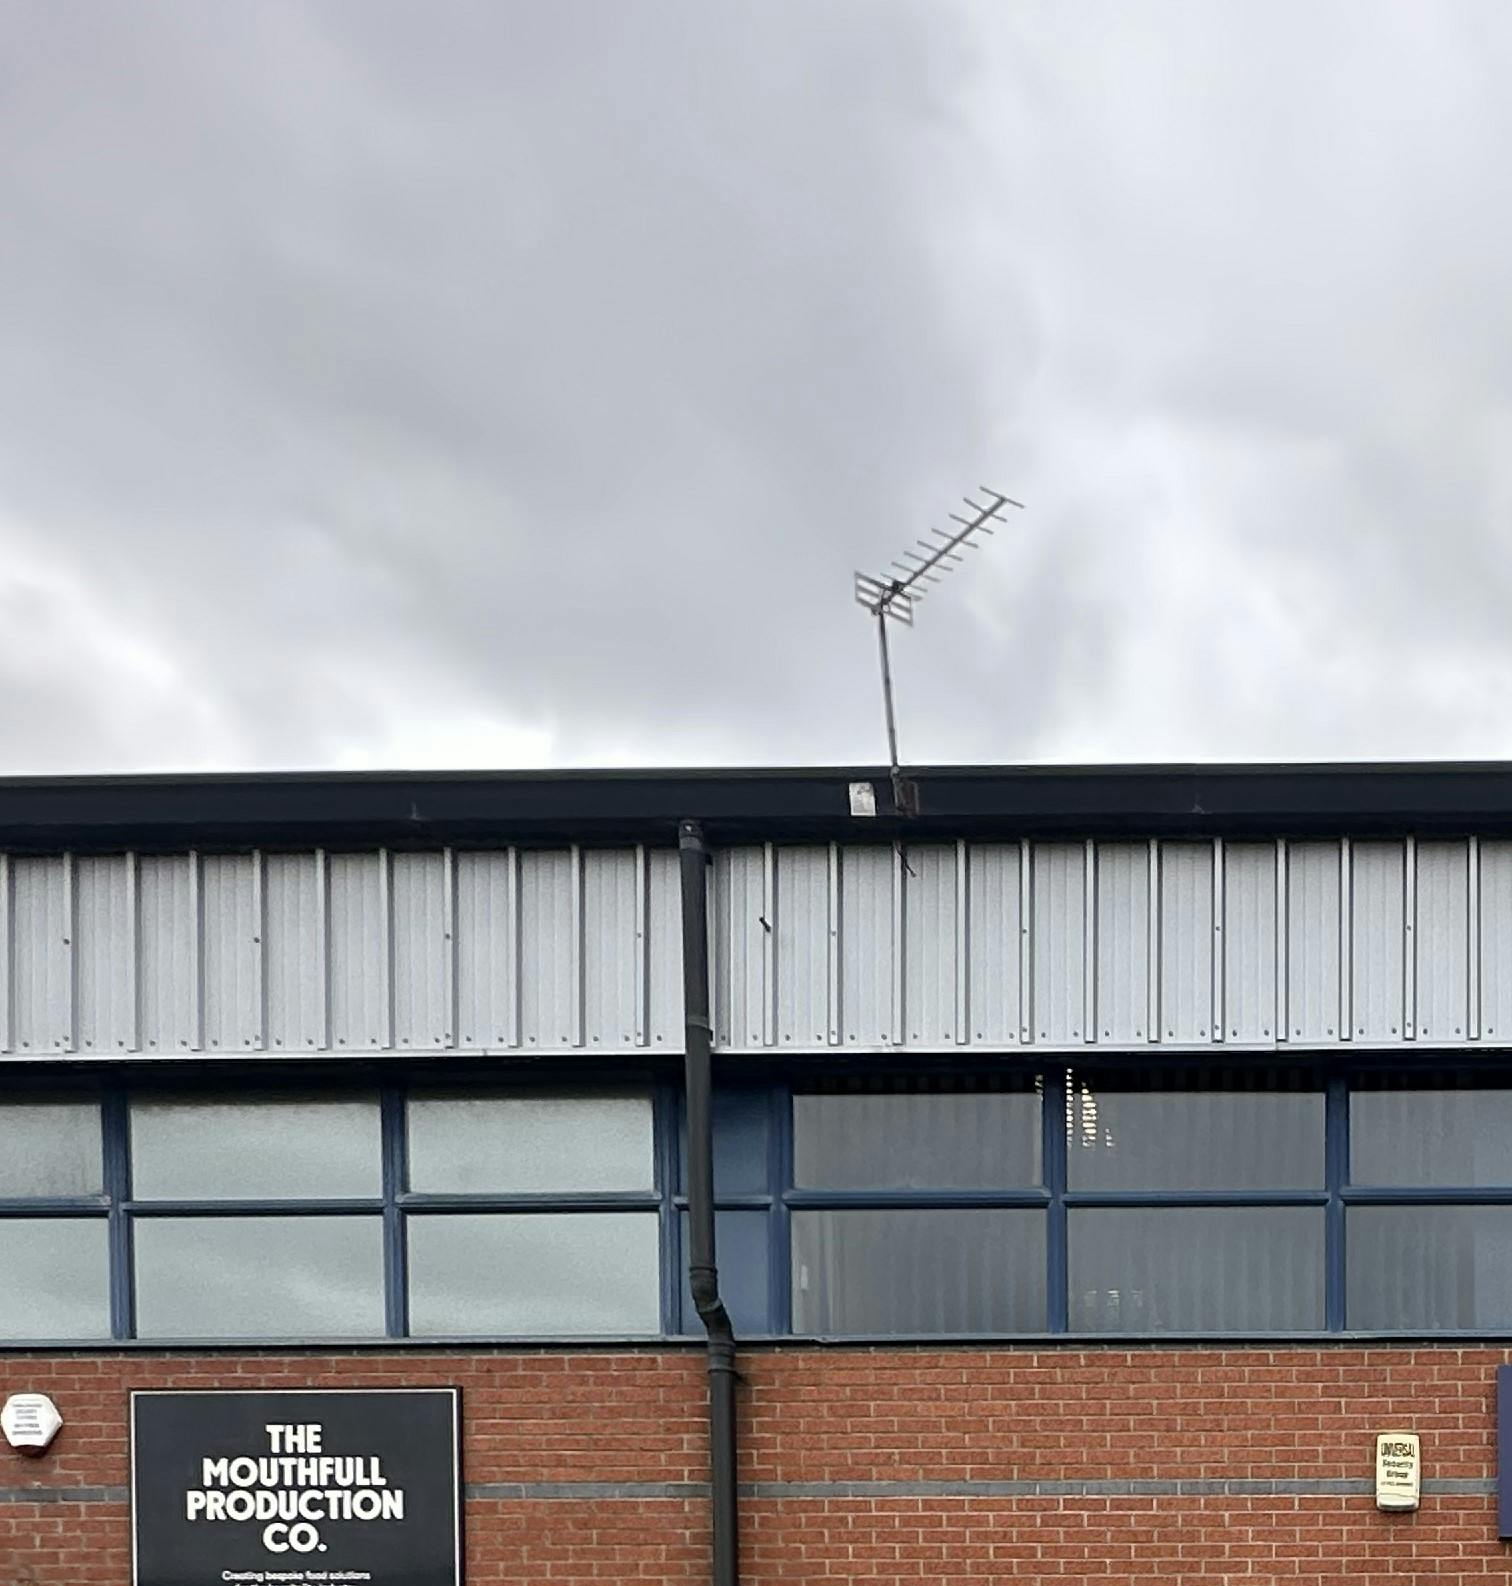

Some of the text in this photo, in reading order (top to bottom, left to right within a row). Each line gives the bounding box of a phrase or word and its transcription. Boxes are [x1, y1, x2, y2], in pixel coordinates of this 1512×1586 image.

[265, 1424, 322, 1453] THE
[202, 1456, 387, 1487] MOUTHFULL
[186, 1488, 404, 1521] PRODUCTION
[262, 1522, 328, 1552] CO.
